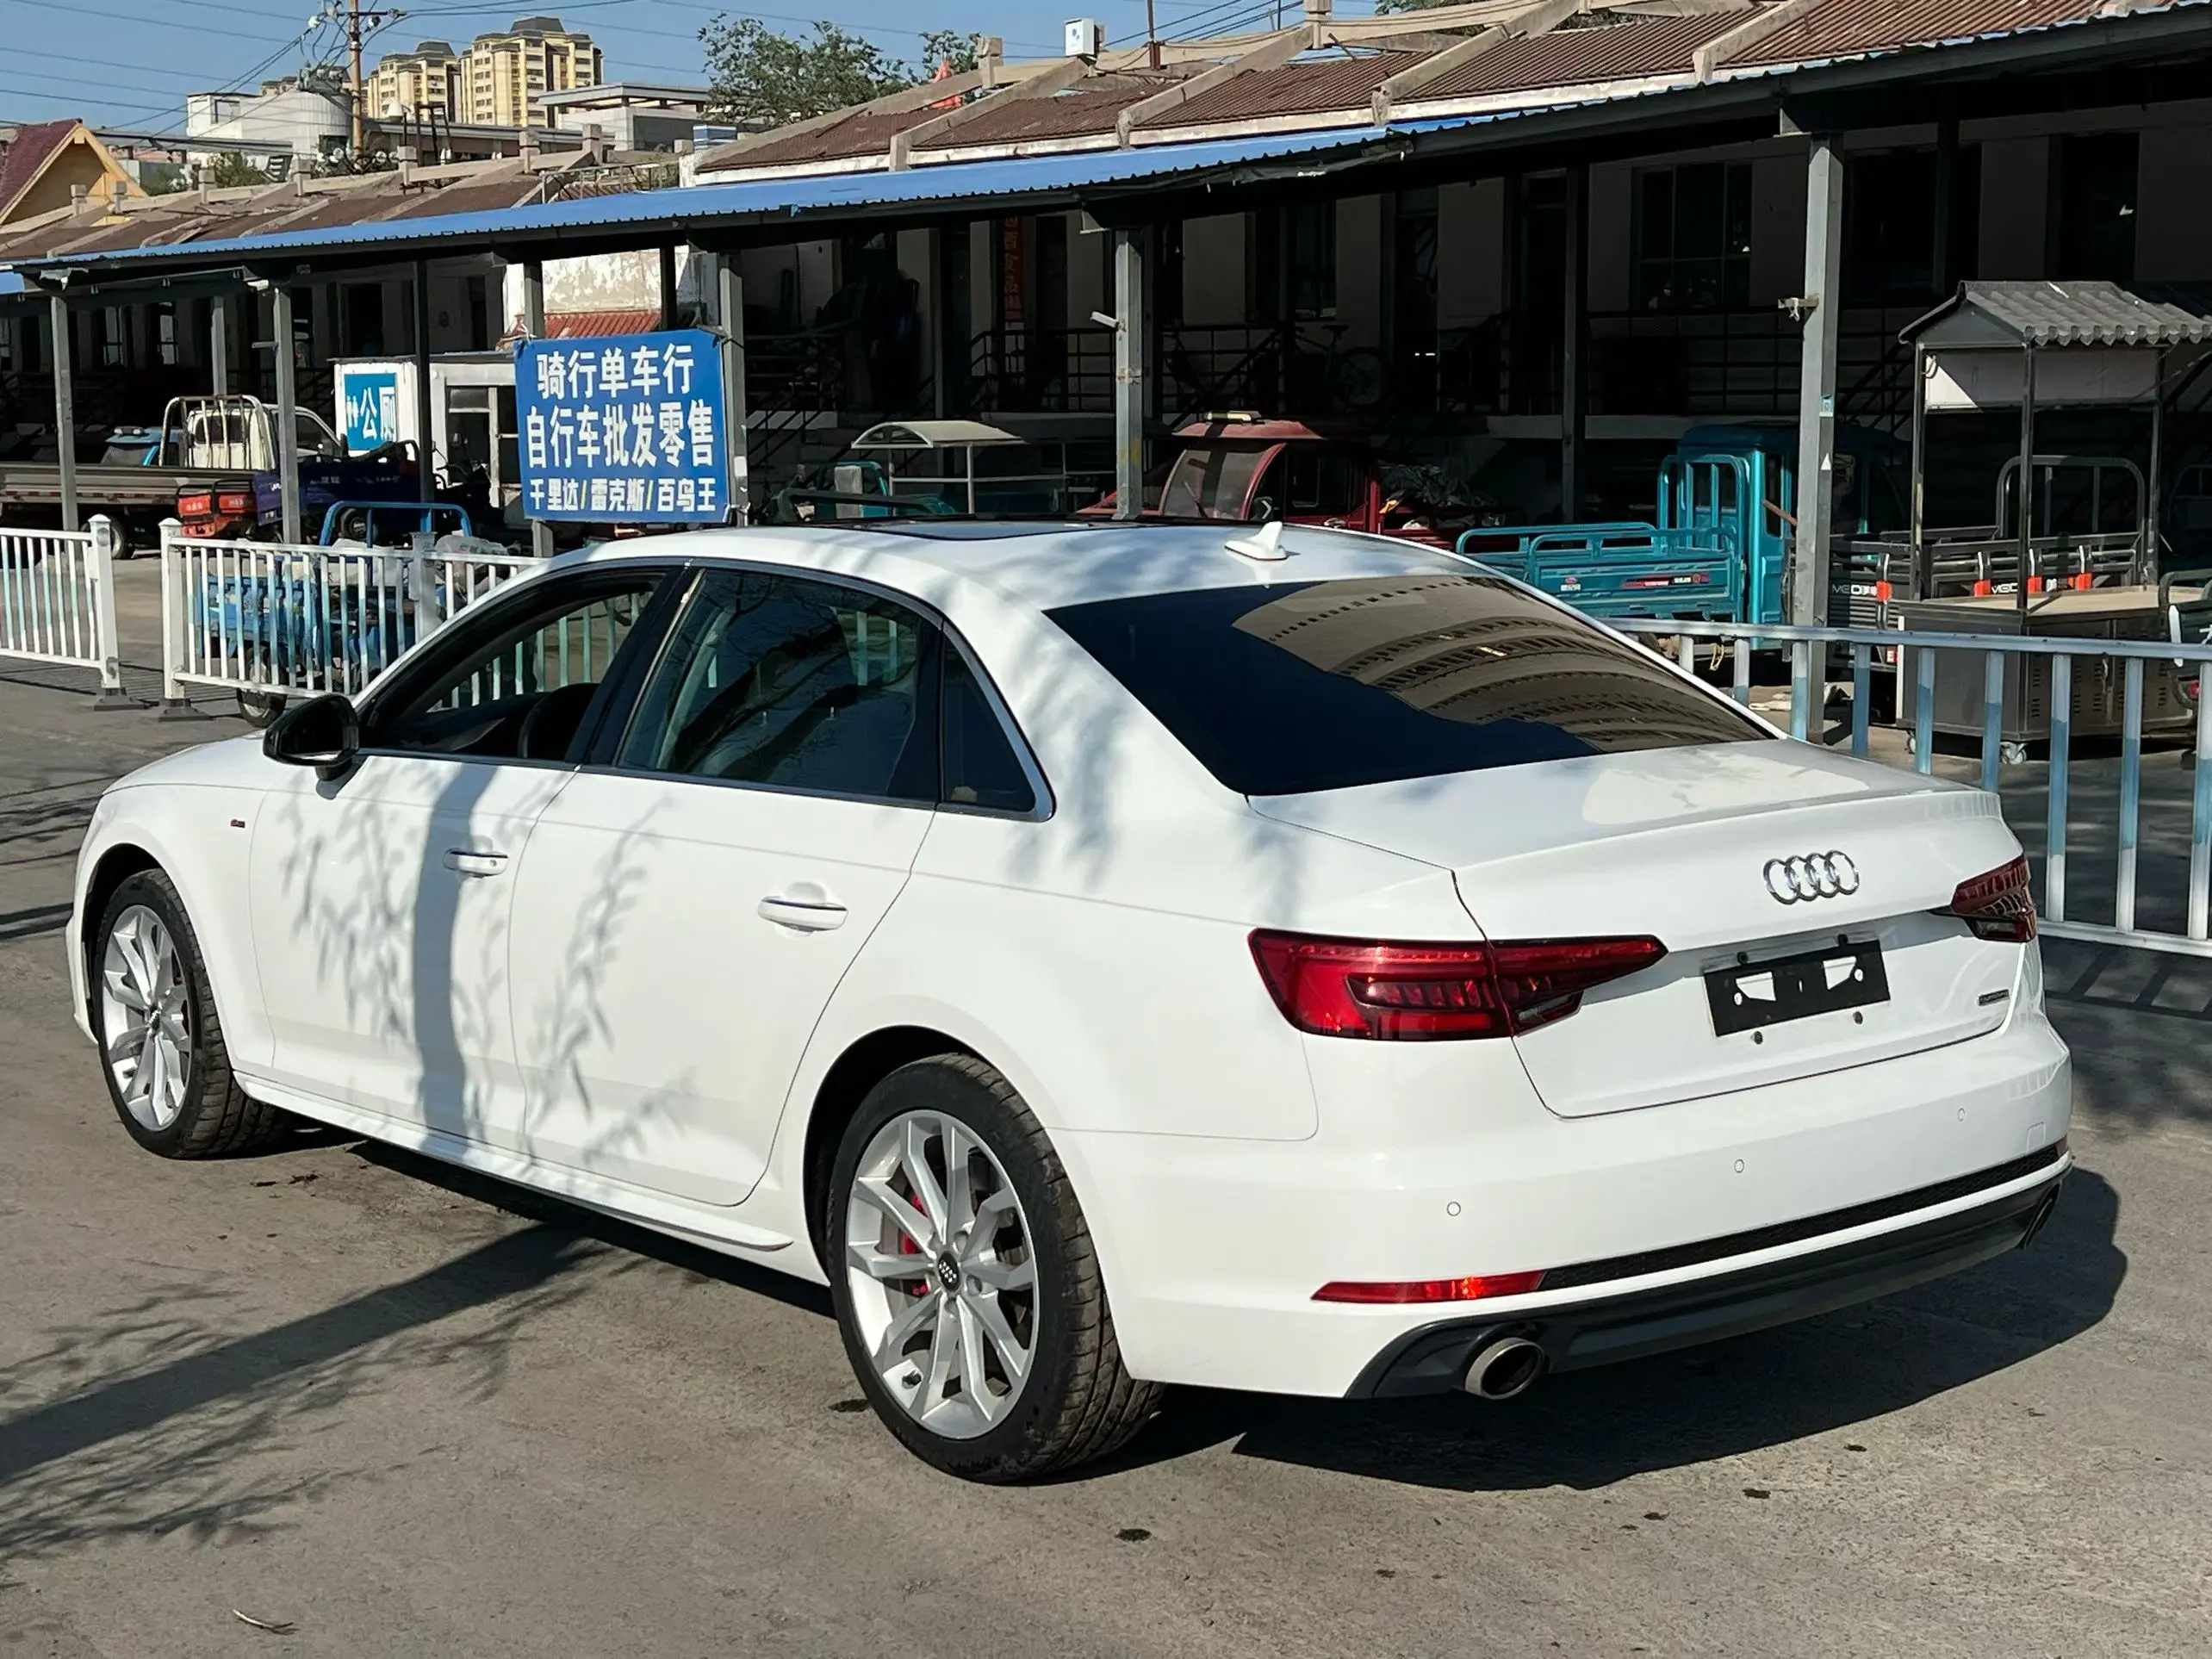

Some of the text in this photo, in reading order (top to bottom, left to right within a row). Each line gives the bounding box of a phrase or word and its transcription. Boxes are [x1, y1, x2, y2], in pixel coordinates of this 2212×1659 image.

[537, 343, 694, 400] 骑行单车行
[360, 387, 397, 443] 公厕
[526, 399, 714, 469] 自行车批发零售
